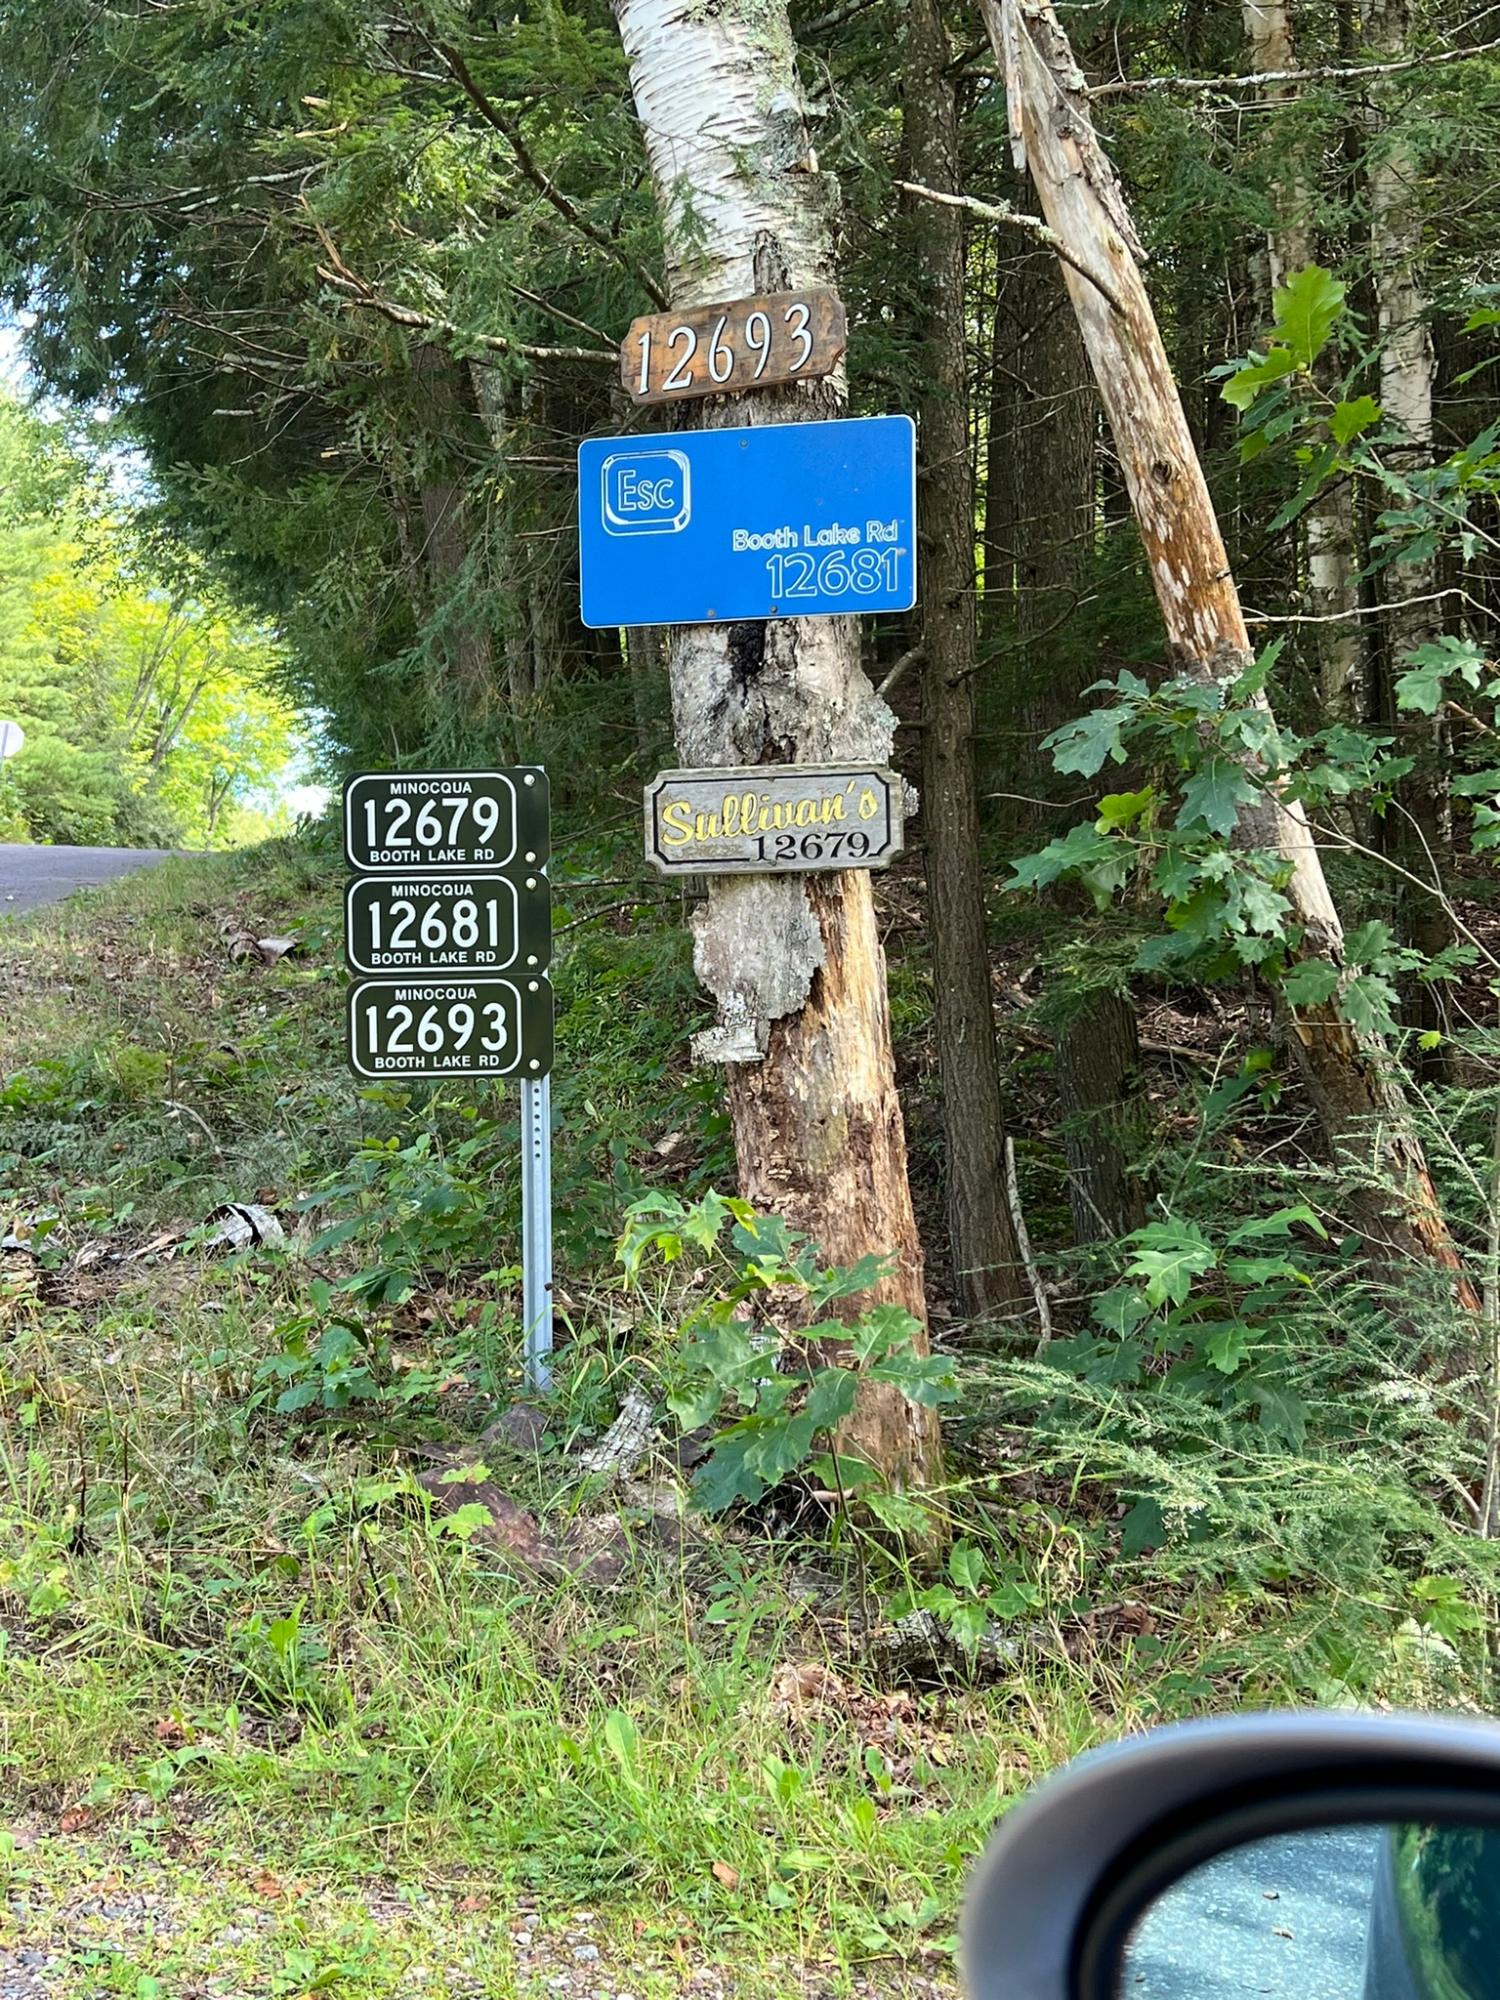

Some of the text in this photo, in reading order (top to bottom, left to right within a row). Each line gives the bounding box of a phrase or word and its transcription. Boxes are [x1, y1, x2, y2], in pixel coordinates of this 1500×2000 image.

[637, 303, 813, 396] 12693
[617, 469, 675, 512] Esc
[732, 519, 899, 552] Booth Lake Rd
[765, 547, 899, 599] 12681
[390, 782, 472, 795] MINOCQUA
[363, 796, 500, 847] 12679
[661, 780, 879, 846] Sullivan's
[370, 848, 495, 862] BOOTH LAKE RD
[752, 831, 871, 862] 12679
[391, 884, 474, 897] MINOCQUA
[368, 899, 498, 949] 12681
[371, 951, 496, 965] BOOTH LAKE RD
[395, 987, 477, 1001] MINOCQUA
[365, 1002, 508, 1053] 12693
[374, 1054, 500, 1069] BOOTH LAKE RD
